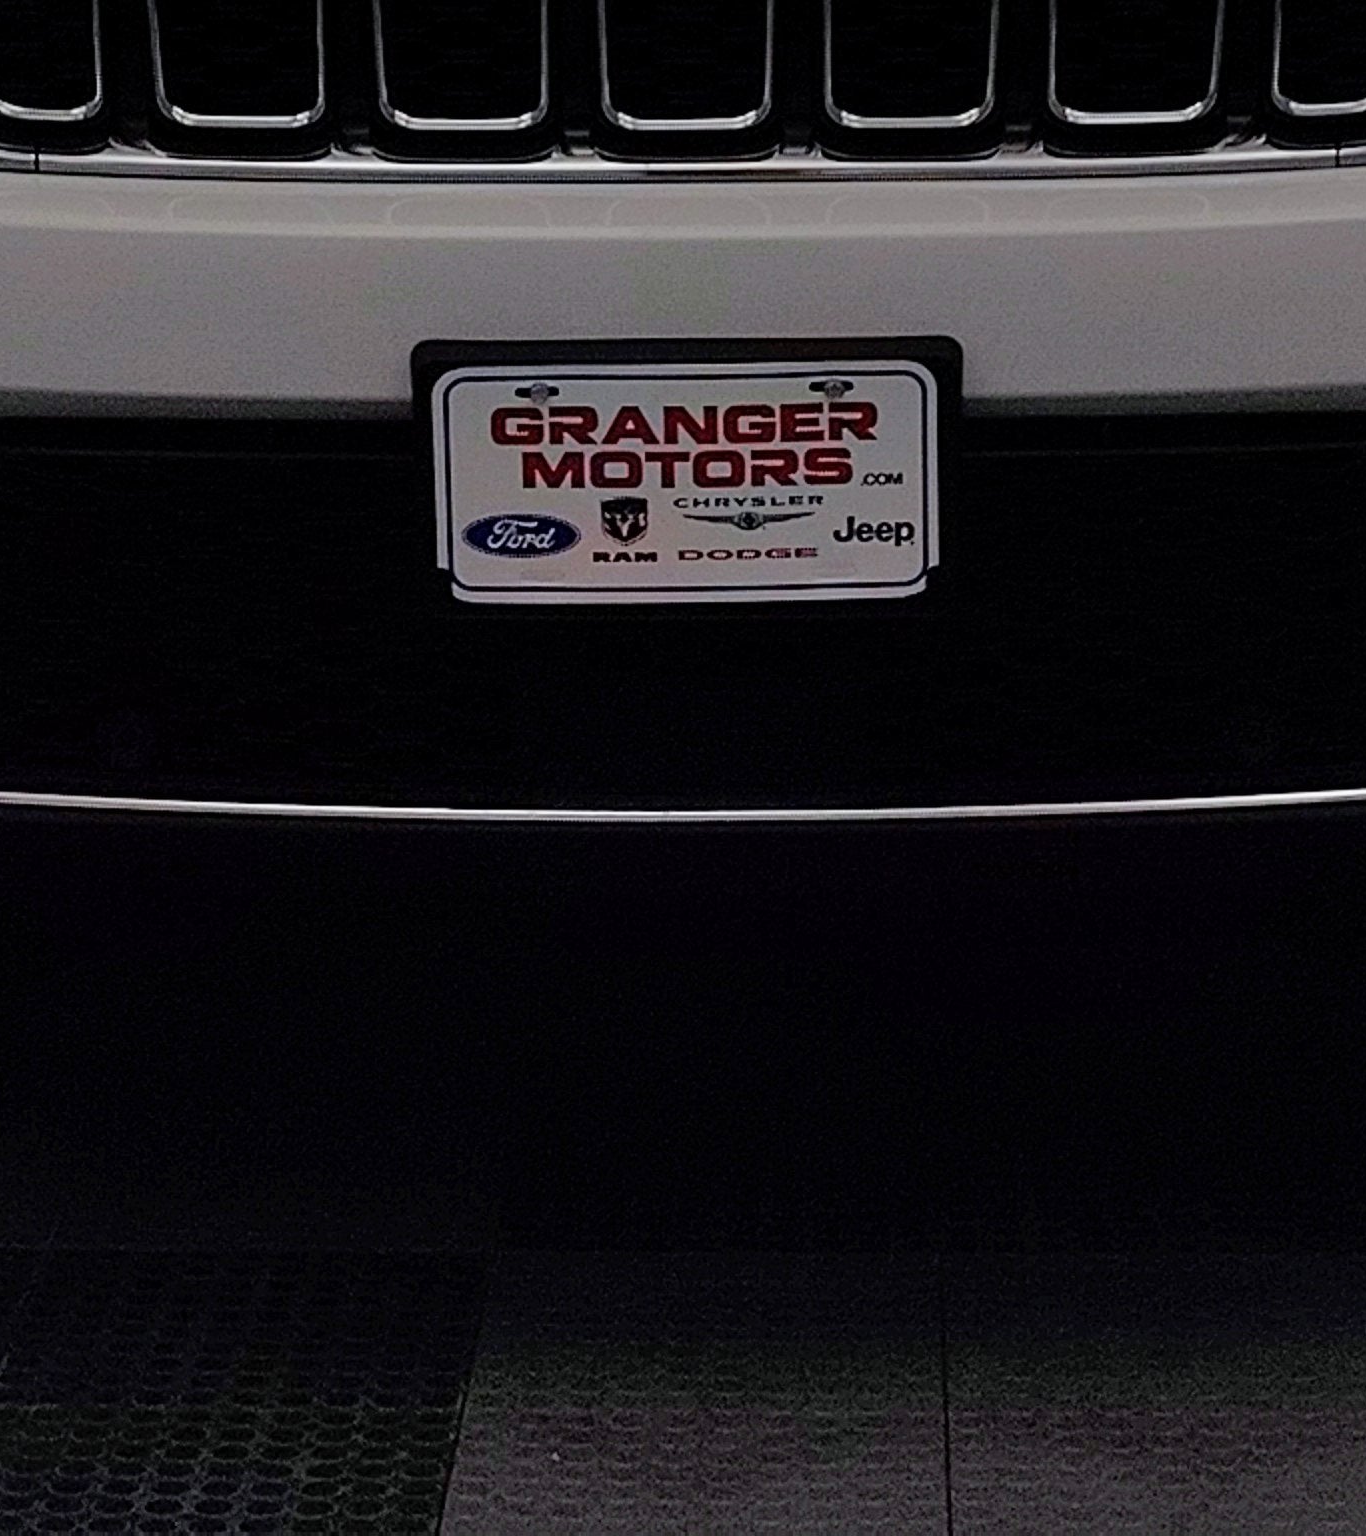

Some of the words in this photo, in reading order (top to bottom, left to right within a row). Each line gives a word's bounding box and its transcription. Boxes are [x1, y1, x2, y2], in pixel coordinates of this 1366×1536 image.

[490, 401, 878, 446] GRANGER
[522, 447, 854, 489] MOTORS
[672, 495, 825, 509] CHRYSLER
[485, 519, 557, 550] Ford
[832, 515, 915, 547] Jeep
[592, 550, 658, 563] RAM
[677, 547, 820, 562] DODGE
